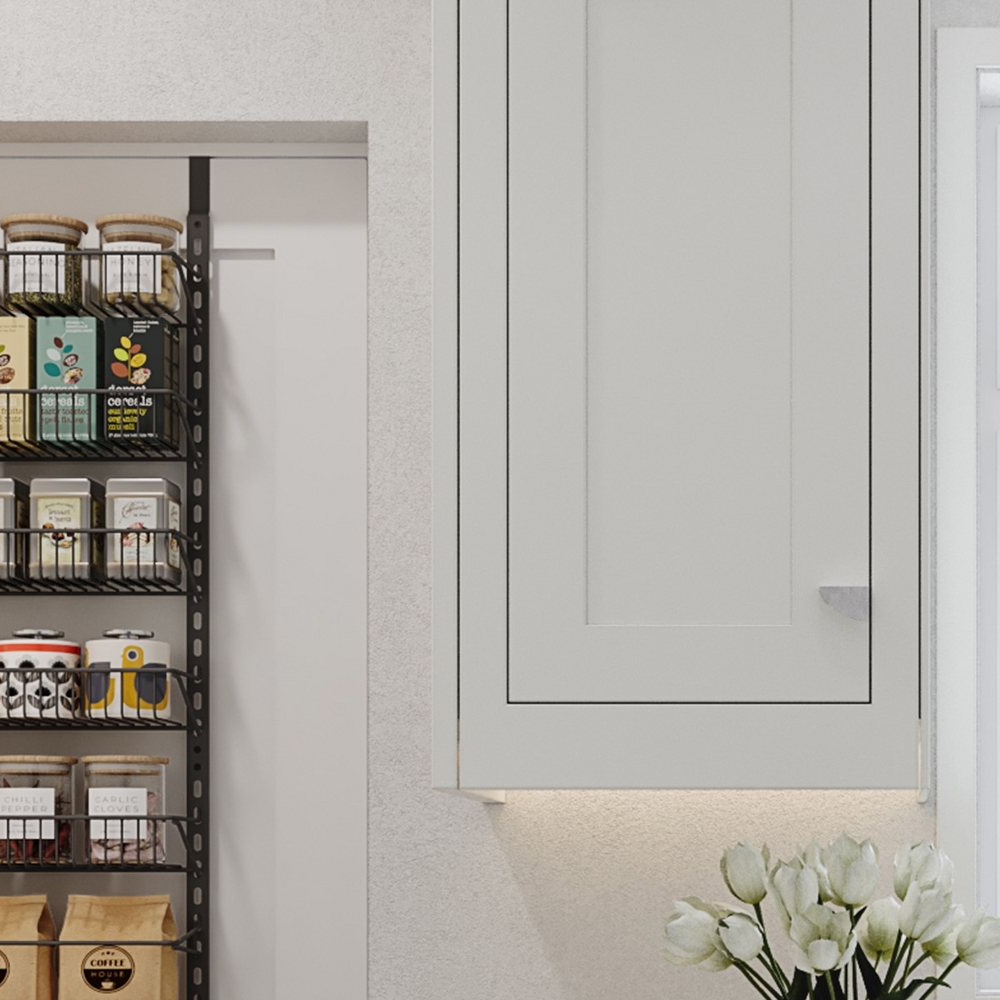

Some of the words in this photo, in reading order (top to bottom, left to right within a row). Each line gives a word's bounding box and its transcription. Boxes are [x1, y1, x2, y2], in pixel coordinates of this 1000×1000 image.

[1, 805, 48, 813] PEPPER
[94, 805, 140, 813] CLOVES
[90, 959, 125, 967] COFFEE
